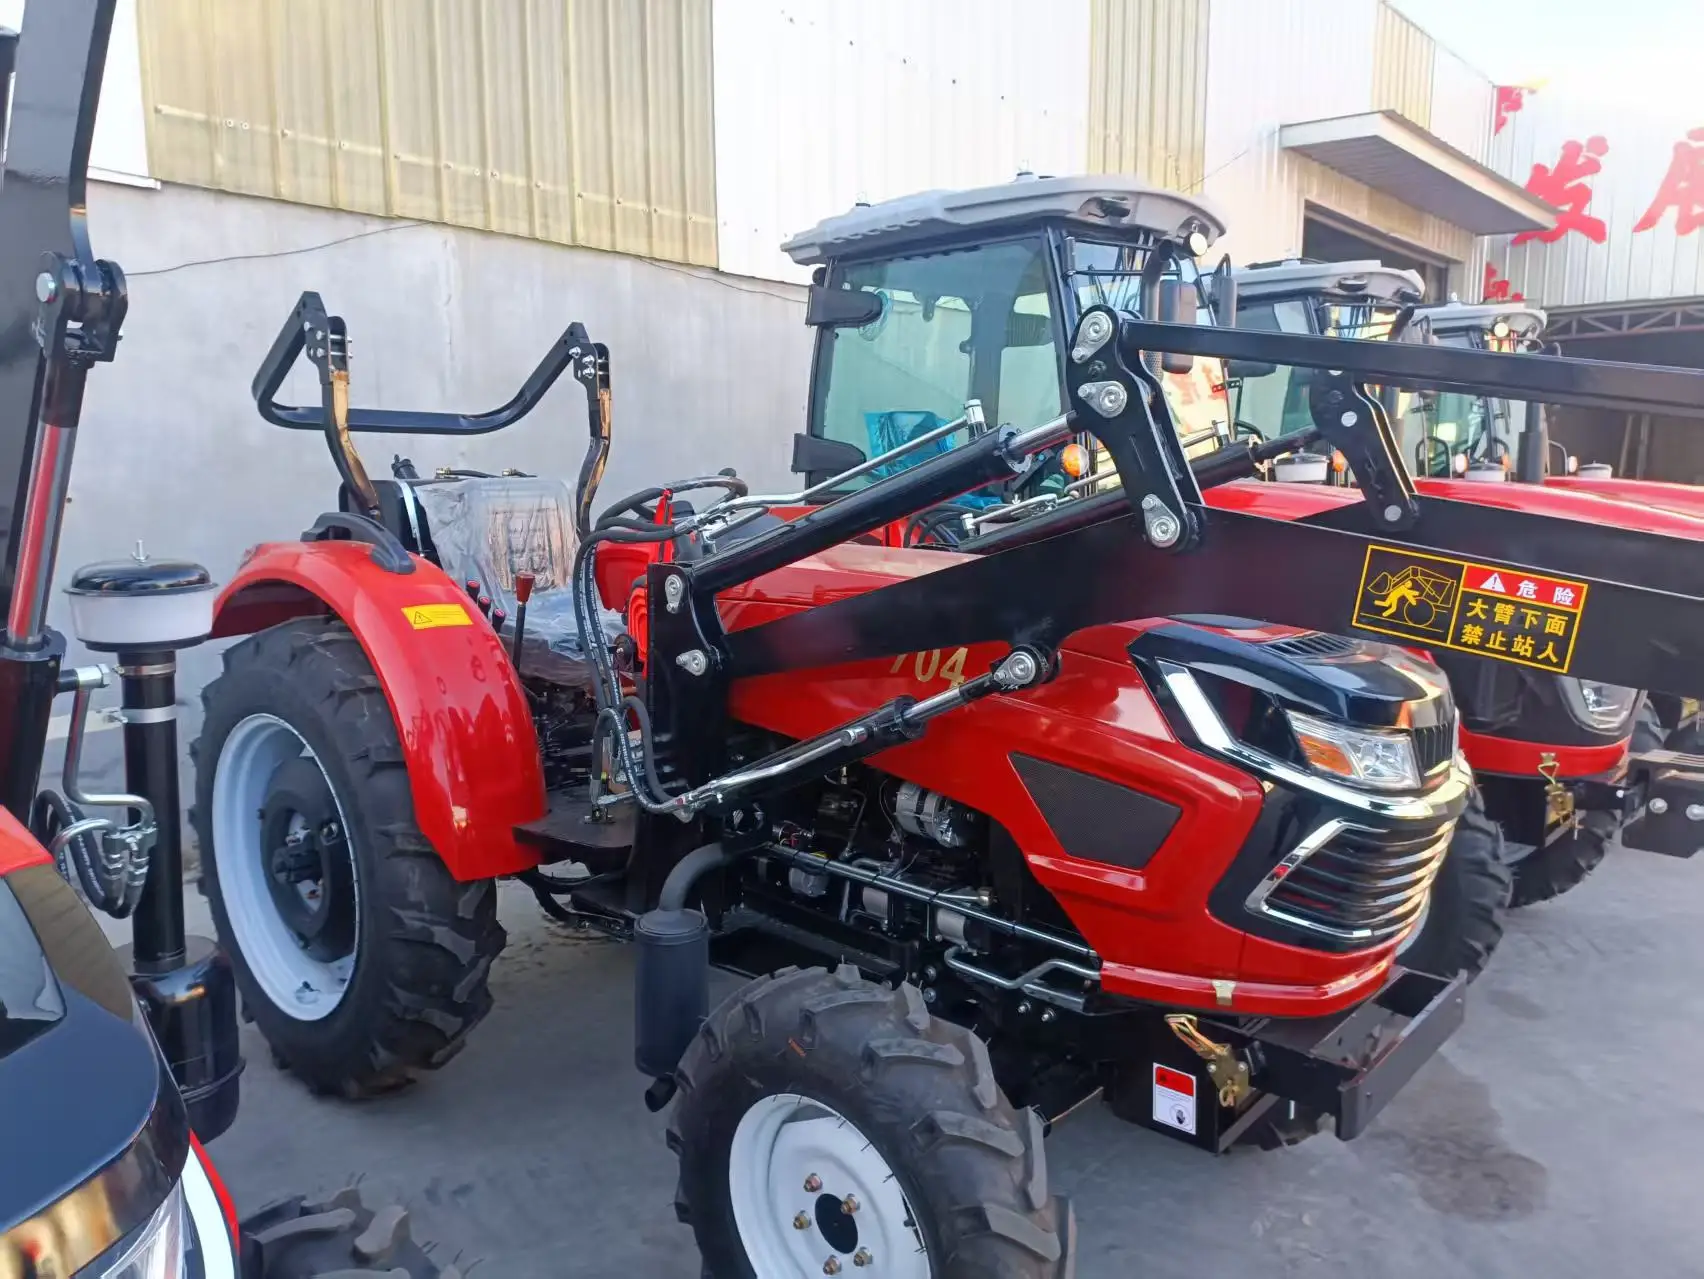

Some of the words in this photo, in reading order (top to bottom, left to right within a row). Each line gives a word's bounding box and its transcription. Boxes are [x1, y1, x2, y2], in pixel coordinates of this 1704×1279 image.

[1516, 580, 1575, 605] 危险
[1467, 599, 1568, 636] 大臂下面
[1461, 624, 1558, 663] 禁止站人
